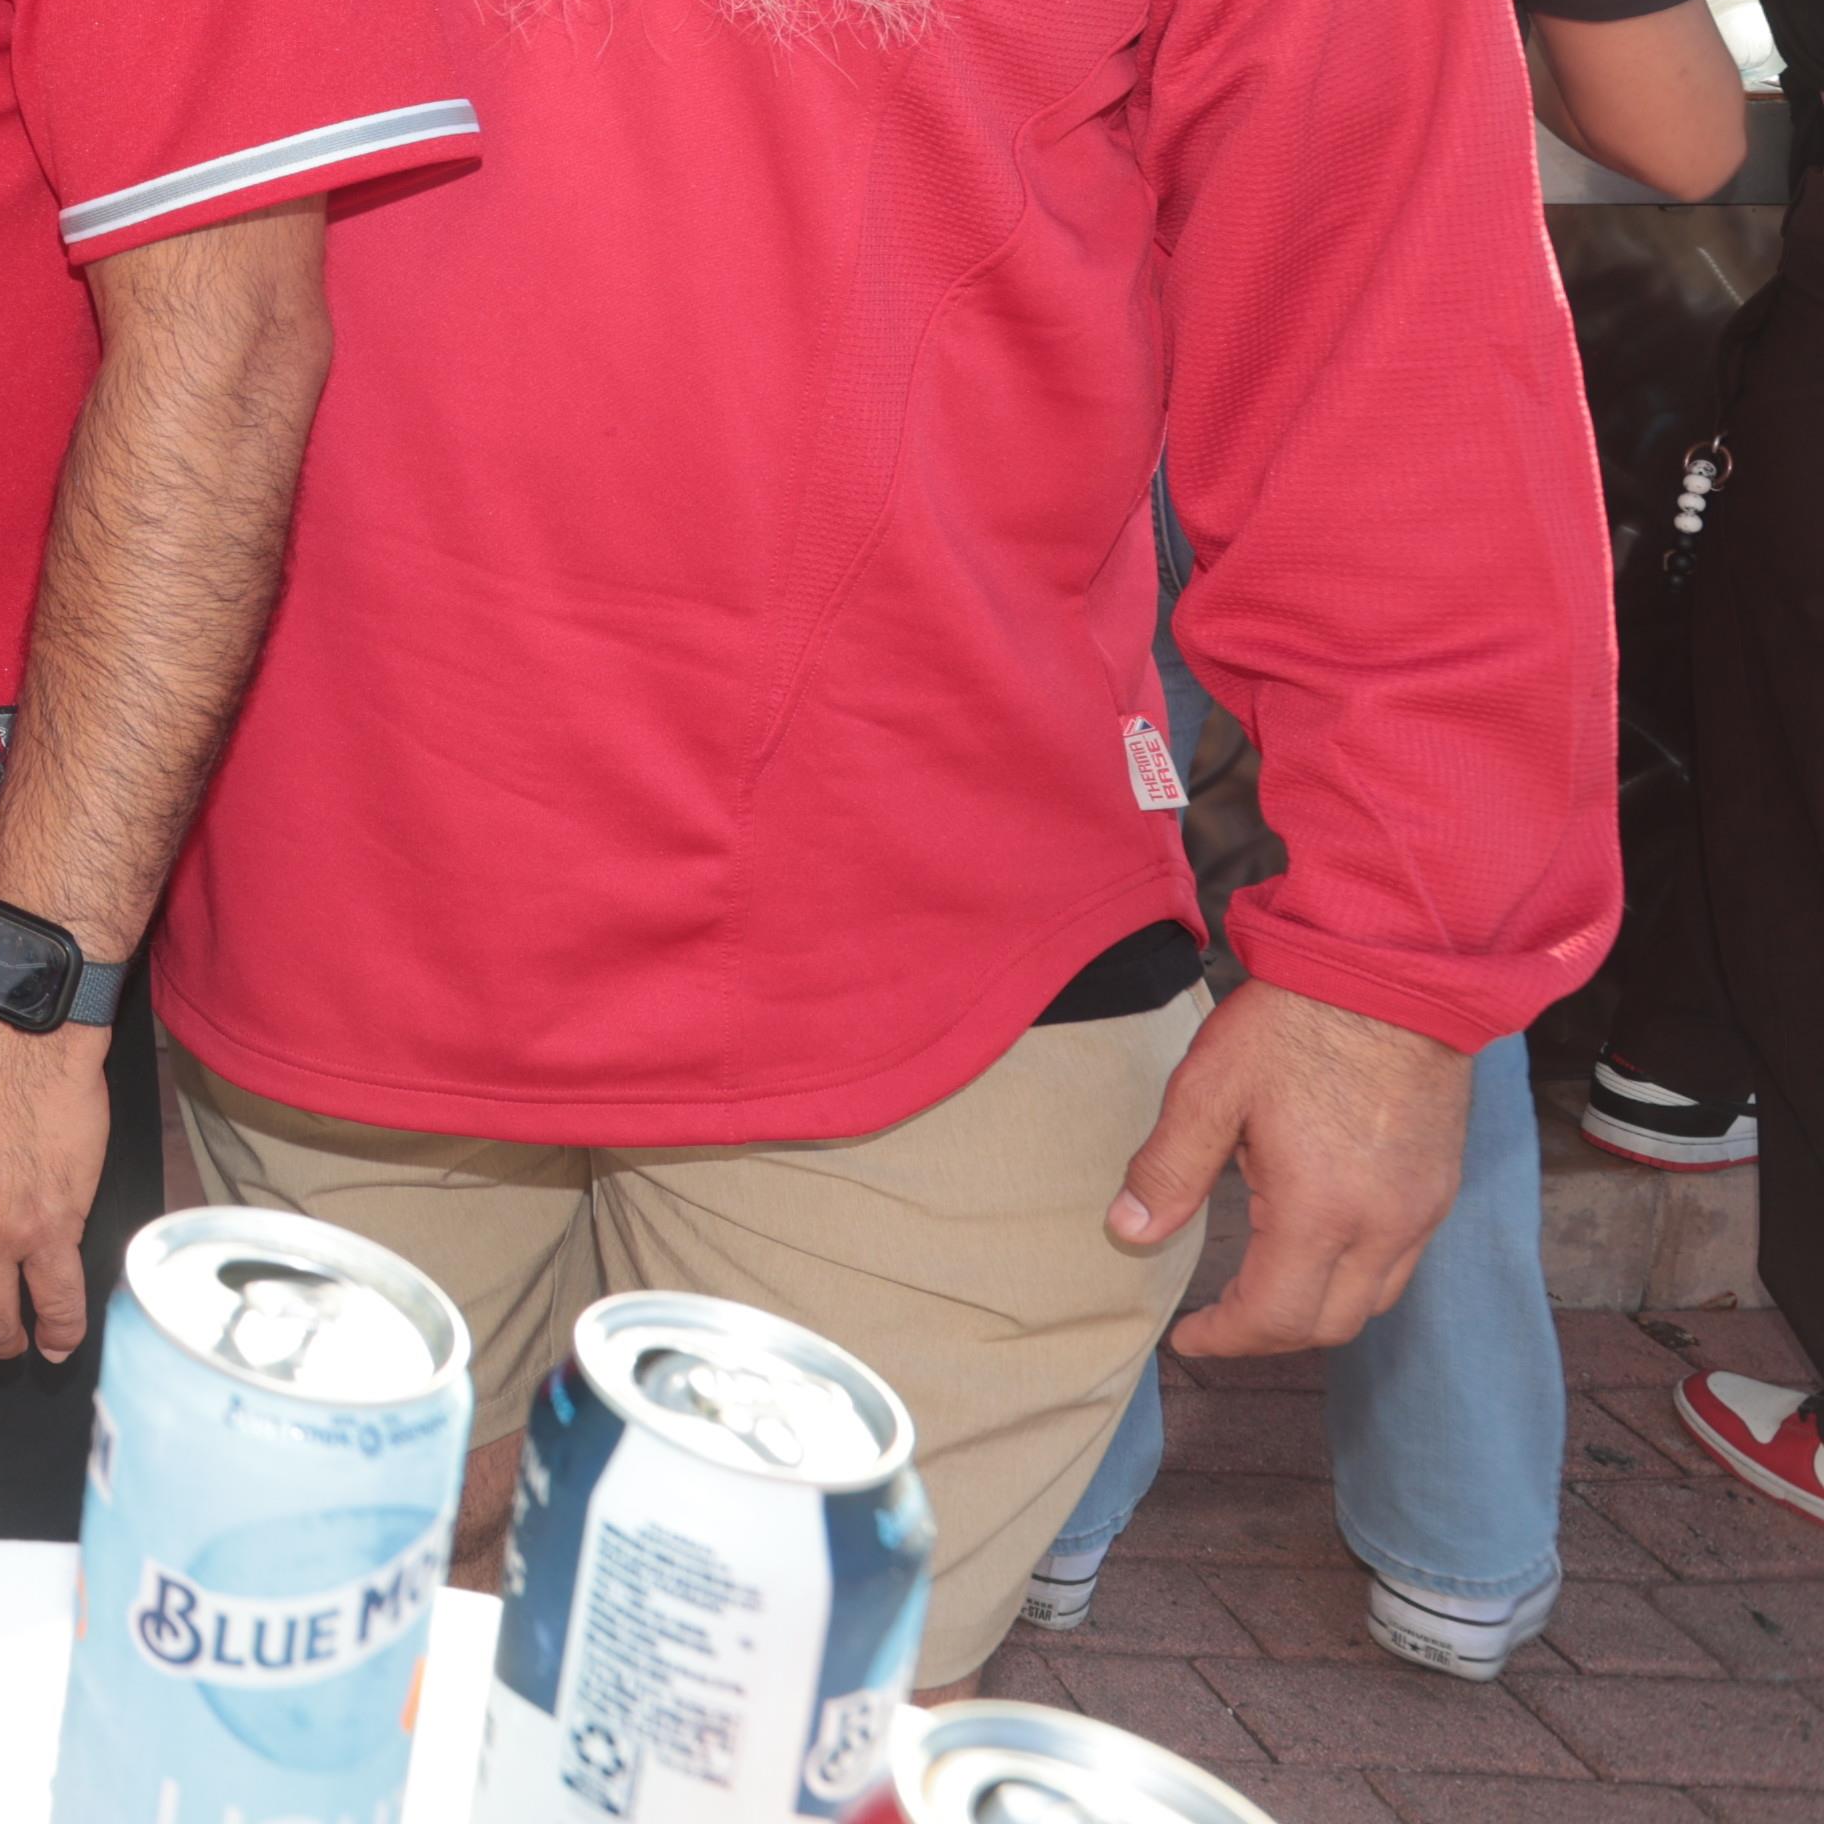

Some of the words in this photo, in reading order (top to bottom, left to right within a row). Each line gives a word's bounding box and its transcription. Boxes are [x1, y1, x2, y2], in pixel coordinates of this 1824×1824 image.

[1129, 740, 1164, 801] THERMA
[1146, 738, 1180, 799] BASE
[138, 1573, 342, 1670] BLUE
[1027, 1605, 1053, 1622] STAR
